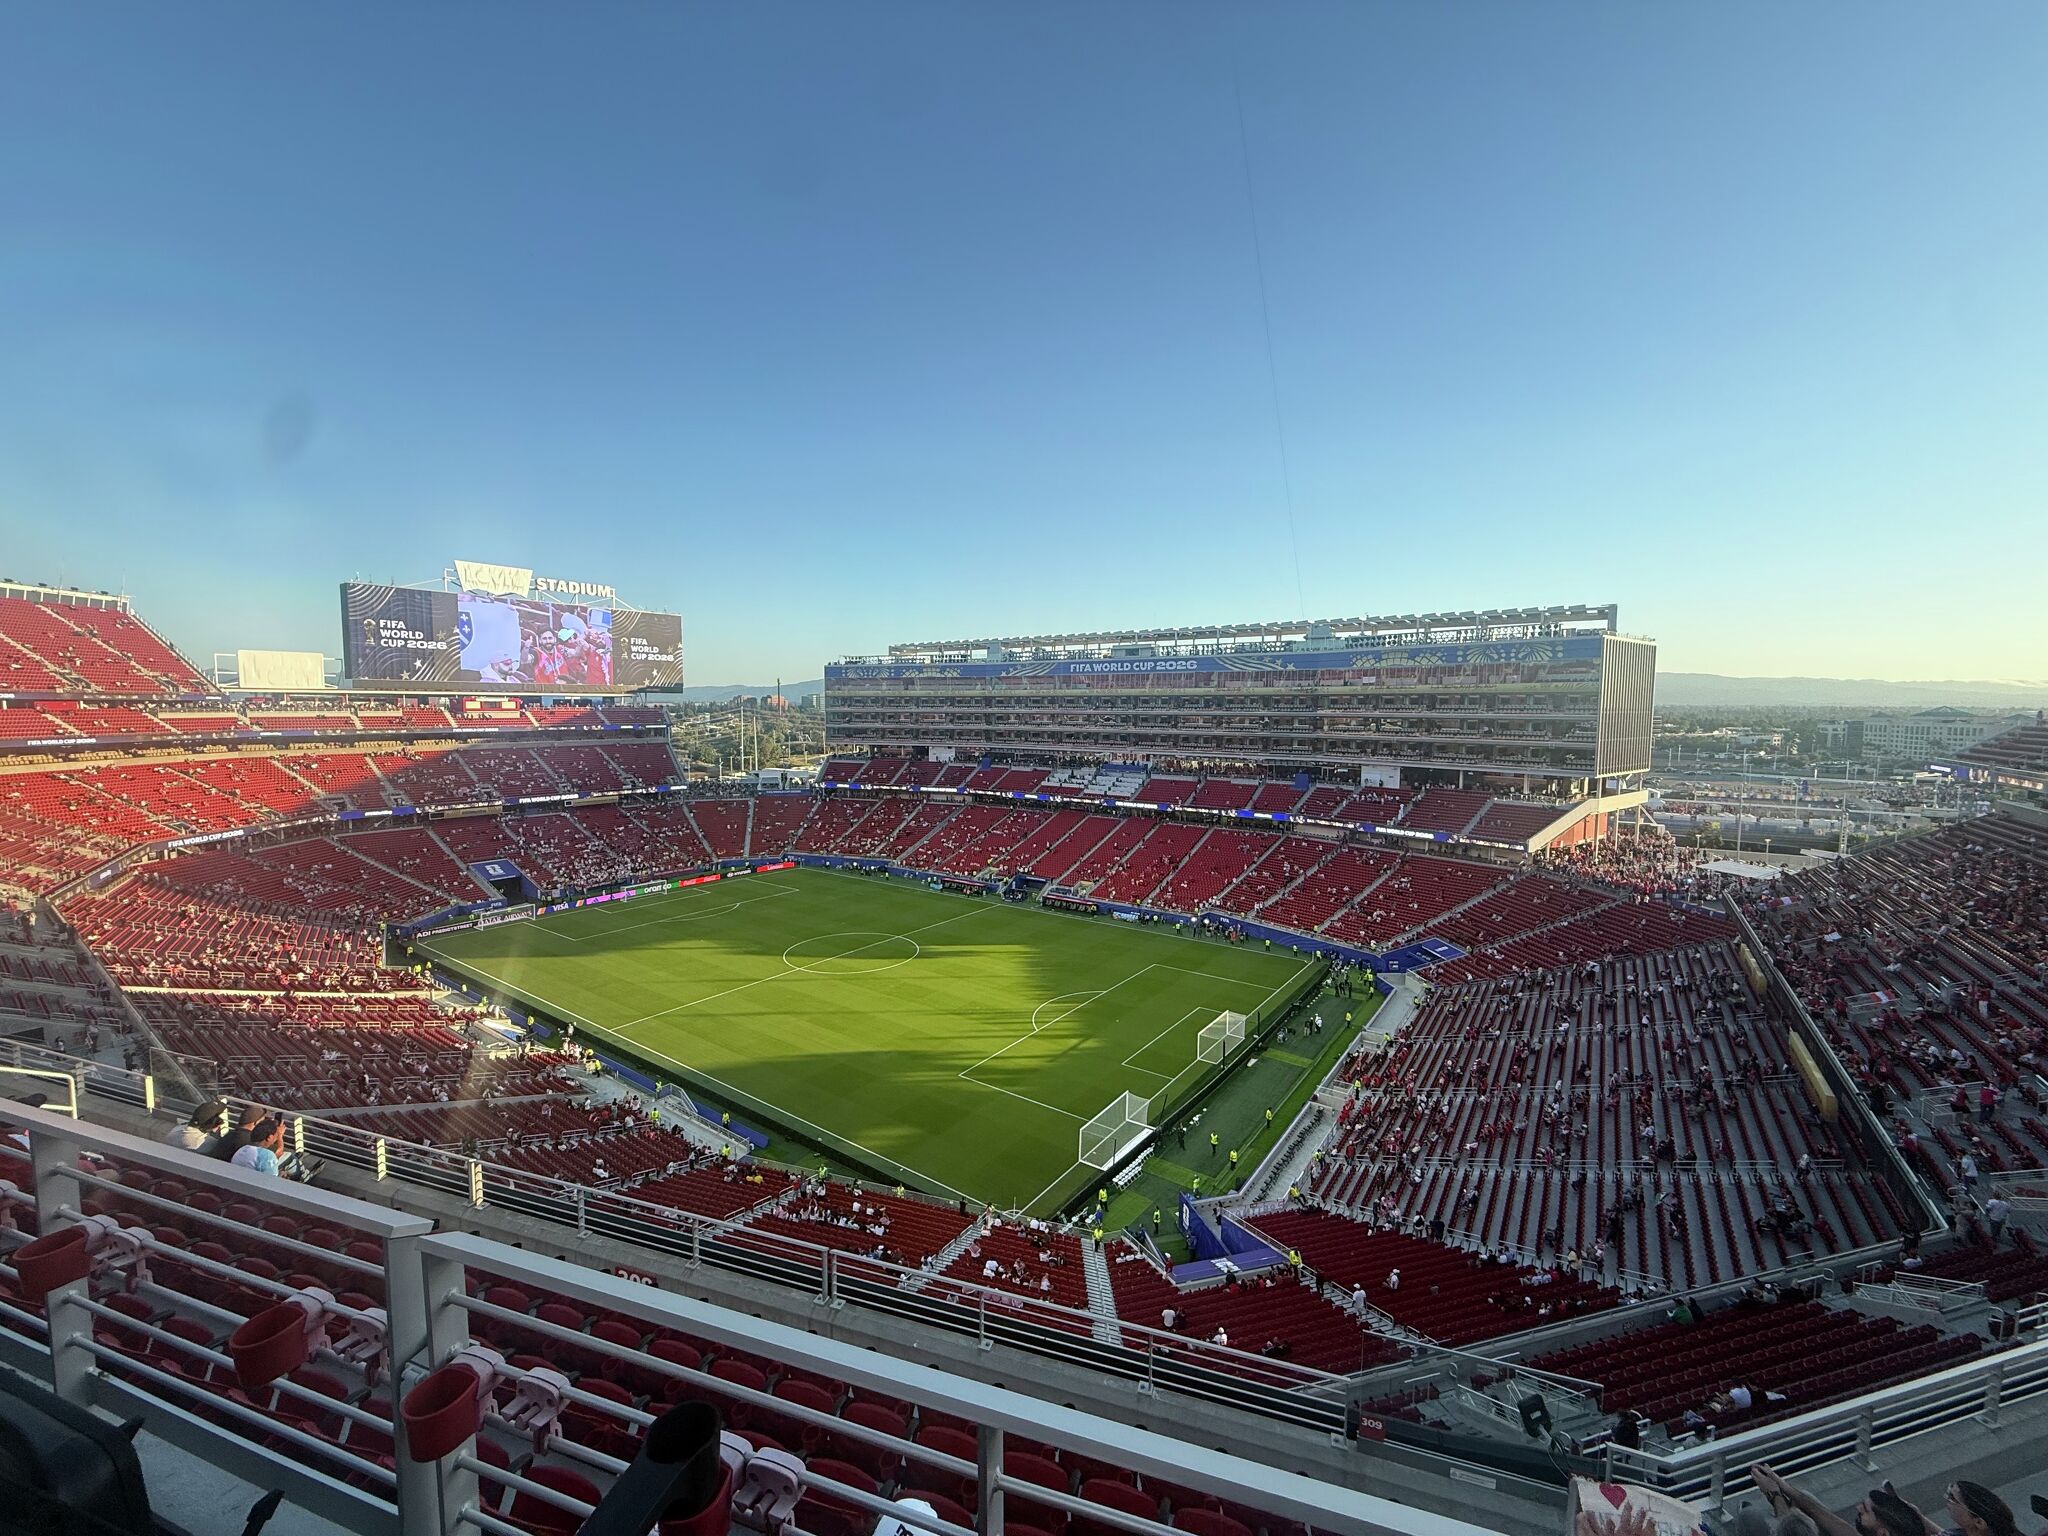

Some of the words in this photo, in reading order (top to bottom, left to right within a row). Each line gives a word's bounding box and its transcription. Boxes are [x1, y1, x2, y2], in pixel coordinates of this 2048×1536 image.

[536, 577, 612, 598] STADIUM
[379, 619, 406, 629] FIFA
[380, 628, 424, 639] WORLD
[380, 638, 405, 648] CUP
[406, 640, 448, 650] 2026
[630, 637, 648, 645] FIFA
[630, 645, 659, 653] WORLD
[631, 652, 648, 660] CUP
[647, 653, 674, 662] 2026
[1070, 664, 1092, 673] FIFA
[1092, 662, 1131, 672] WORLD
[1133, 661, 1155, 671] CUP
[1156, 660, 1198, 670] 2026
[168, 839, 184, 848] FIFA
[184, 836, 209, 845] WORLD
[209, 832, 222, 841] CUP
[222, 829, 244, 839] 2026
[552, 901, 569, 911] VISA
[504, 910, 533, 921] AIRWAYS
[1361, 1417, 1383, 1430] 309
